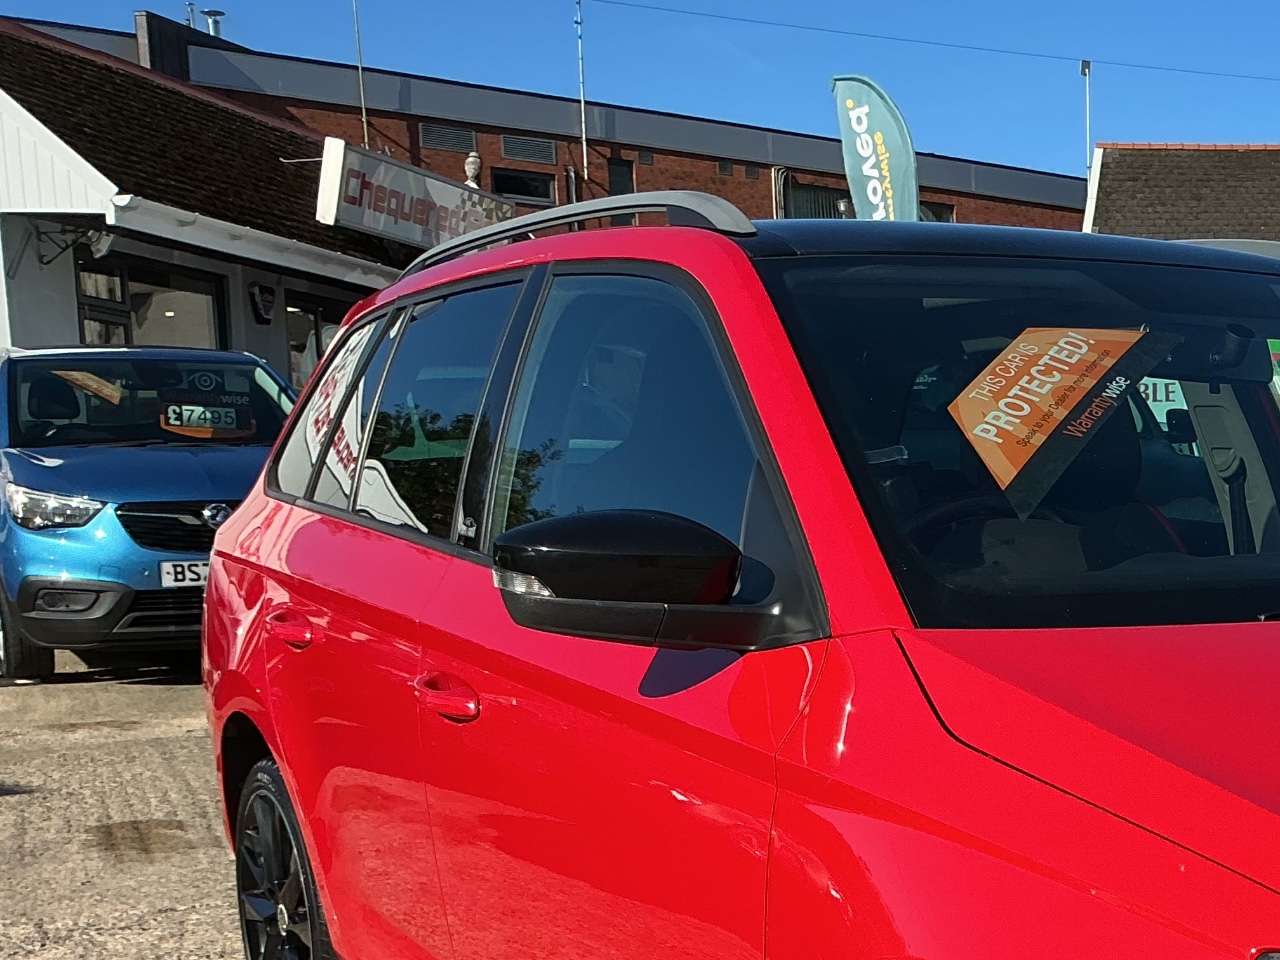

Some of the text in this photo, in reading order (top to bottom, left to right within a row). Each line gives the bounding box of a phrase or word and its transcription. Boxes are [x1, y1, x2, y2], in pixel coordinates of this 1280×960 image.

[969, 343, 1039, 401] THIS CAR IS
[972, 331, 1096, 444] PROTECTED!
[167, 405, 235, 425] £7495
